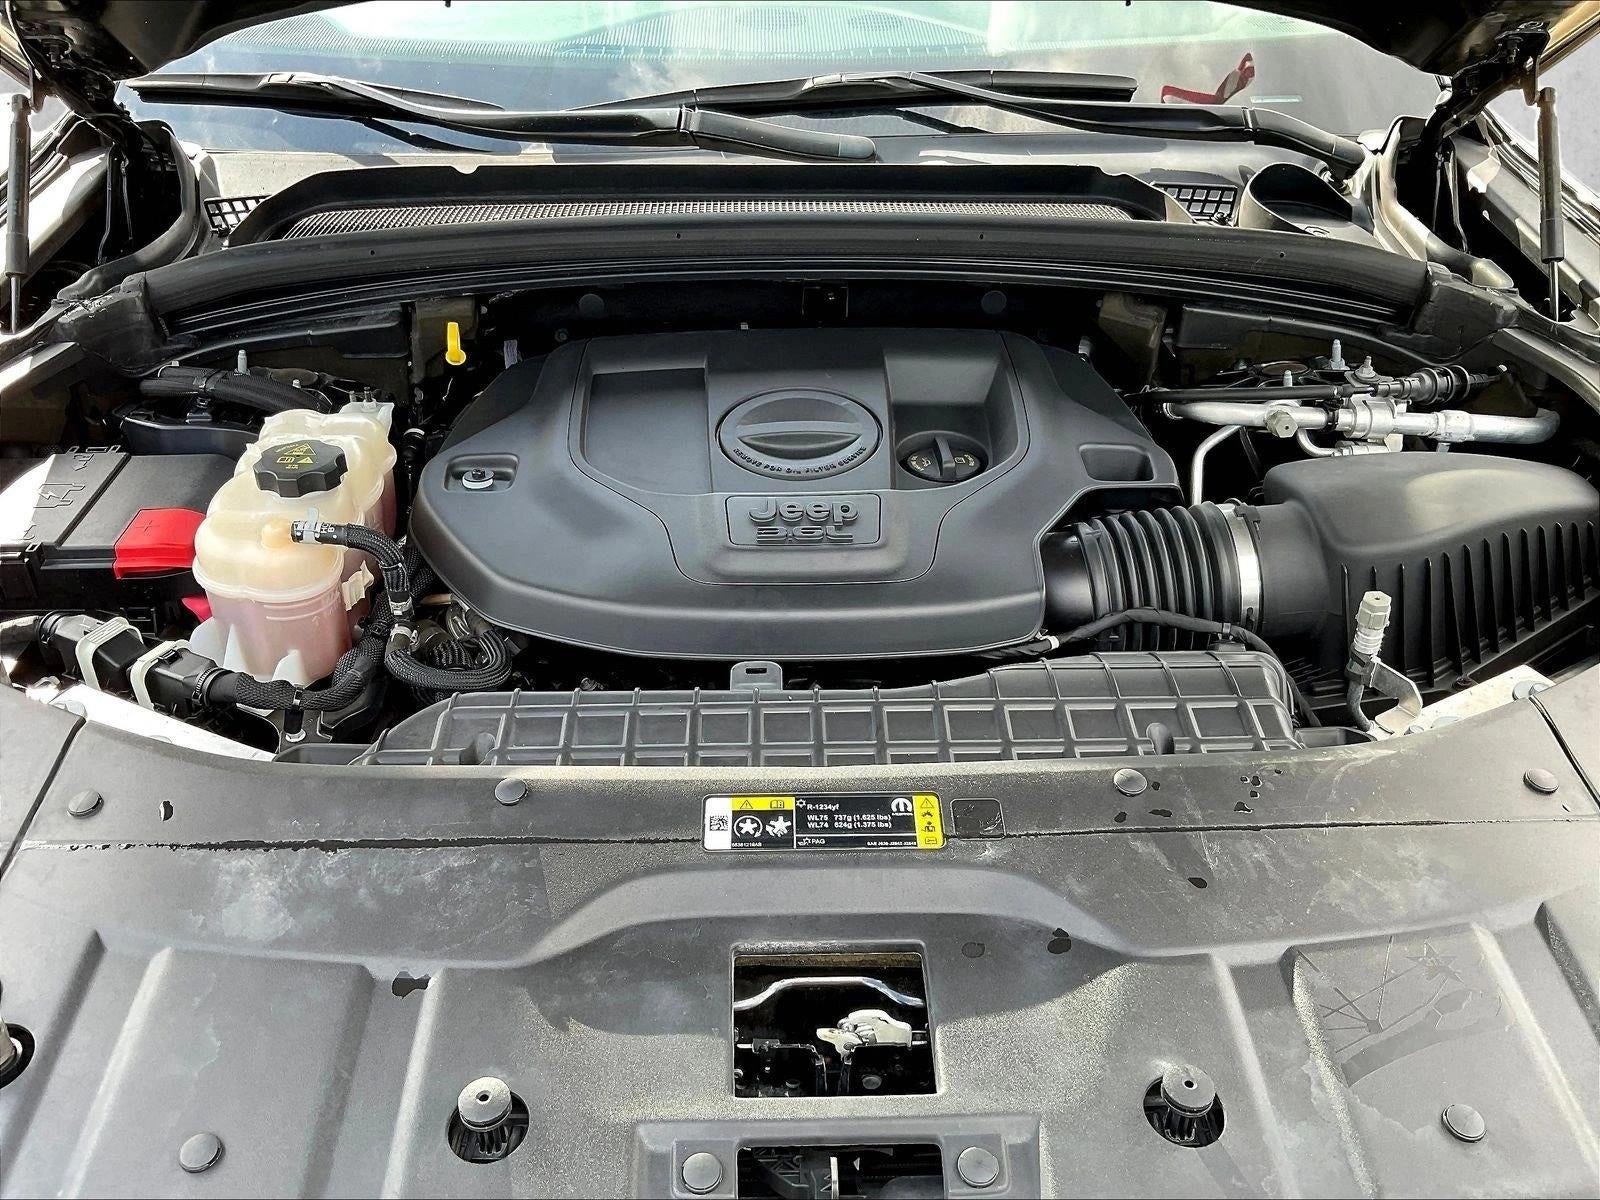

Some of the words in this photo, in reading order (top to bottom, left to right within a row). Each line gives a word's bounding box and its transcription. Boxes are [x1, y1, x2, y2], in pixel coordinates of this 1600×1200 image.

[749, 498, 858, 526] Jeep
[807, 803, 840, 811] R-1234yf
[834, 814, 853, 822] 737g
[854, 821, 877, 829] (1.375
[878, 821, 892, 829] lbs)
